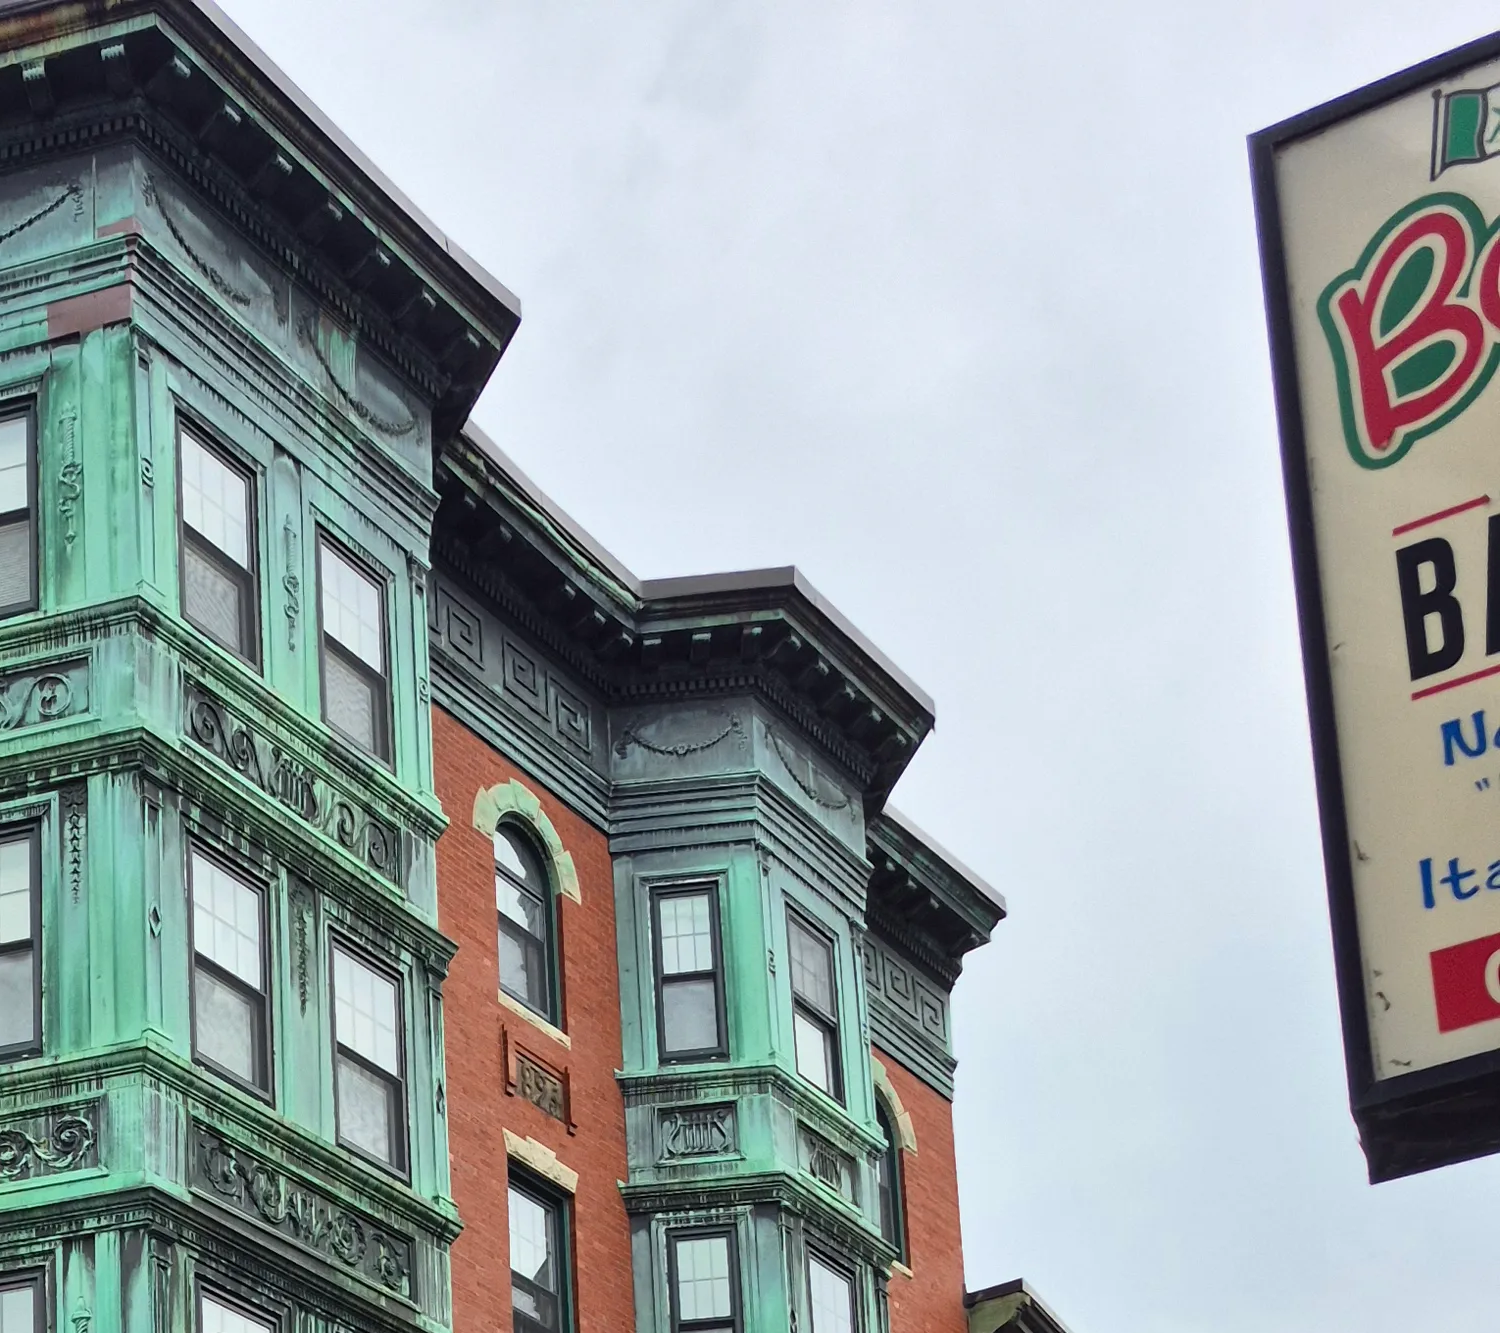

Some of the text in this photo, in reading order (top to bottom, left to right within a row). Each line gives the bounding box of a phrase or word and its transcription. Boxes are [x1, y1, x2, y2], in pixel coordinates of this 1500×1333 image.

[1320, 195, 1500, 465] B
[1396, 514, 1500, 682] B
[1440, 709, 1500, 766] N
